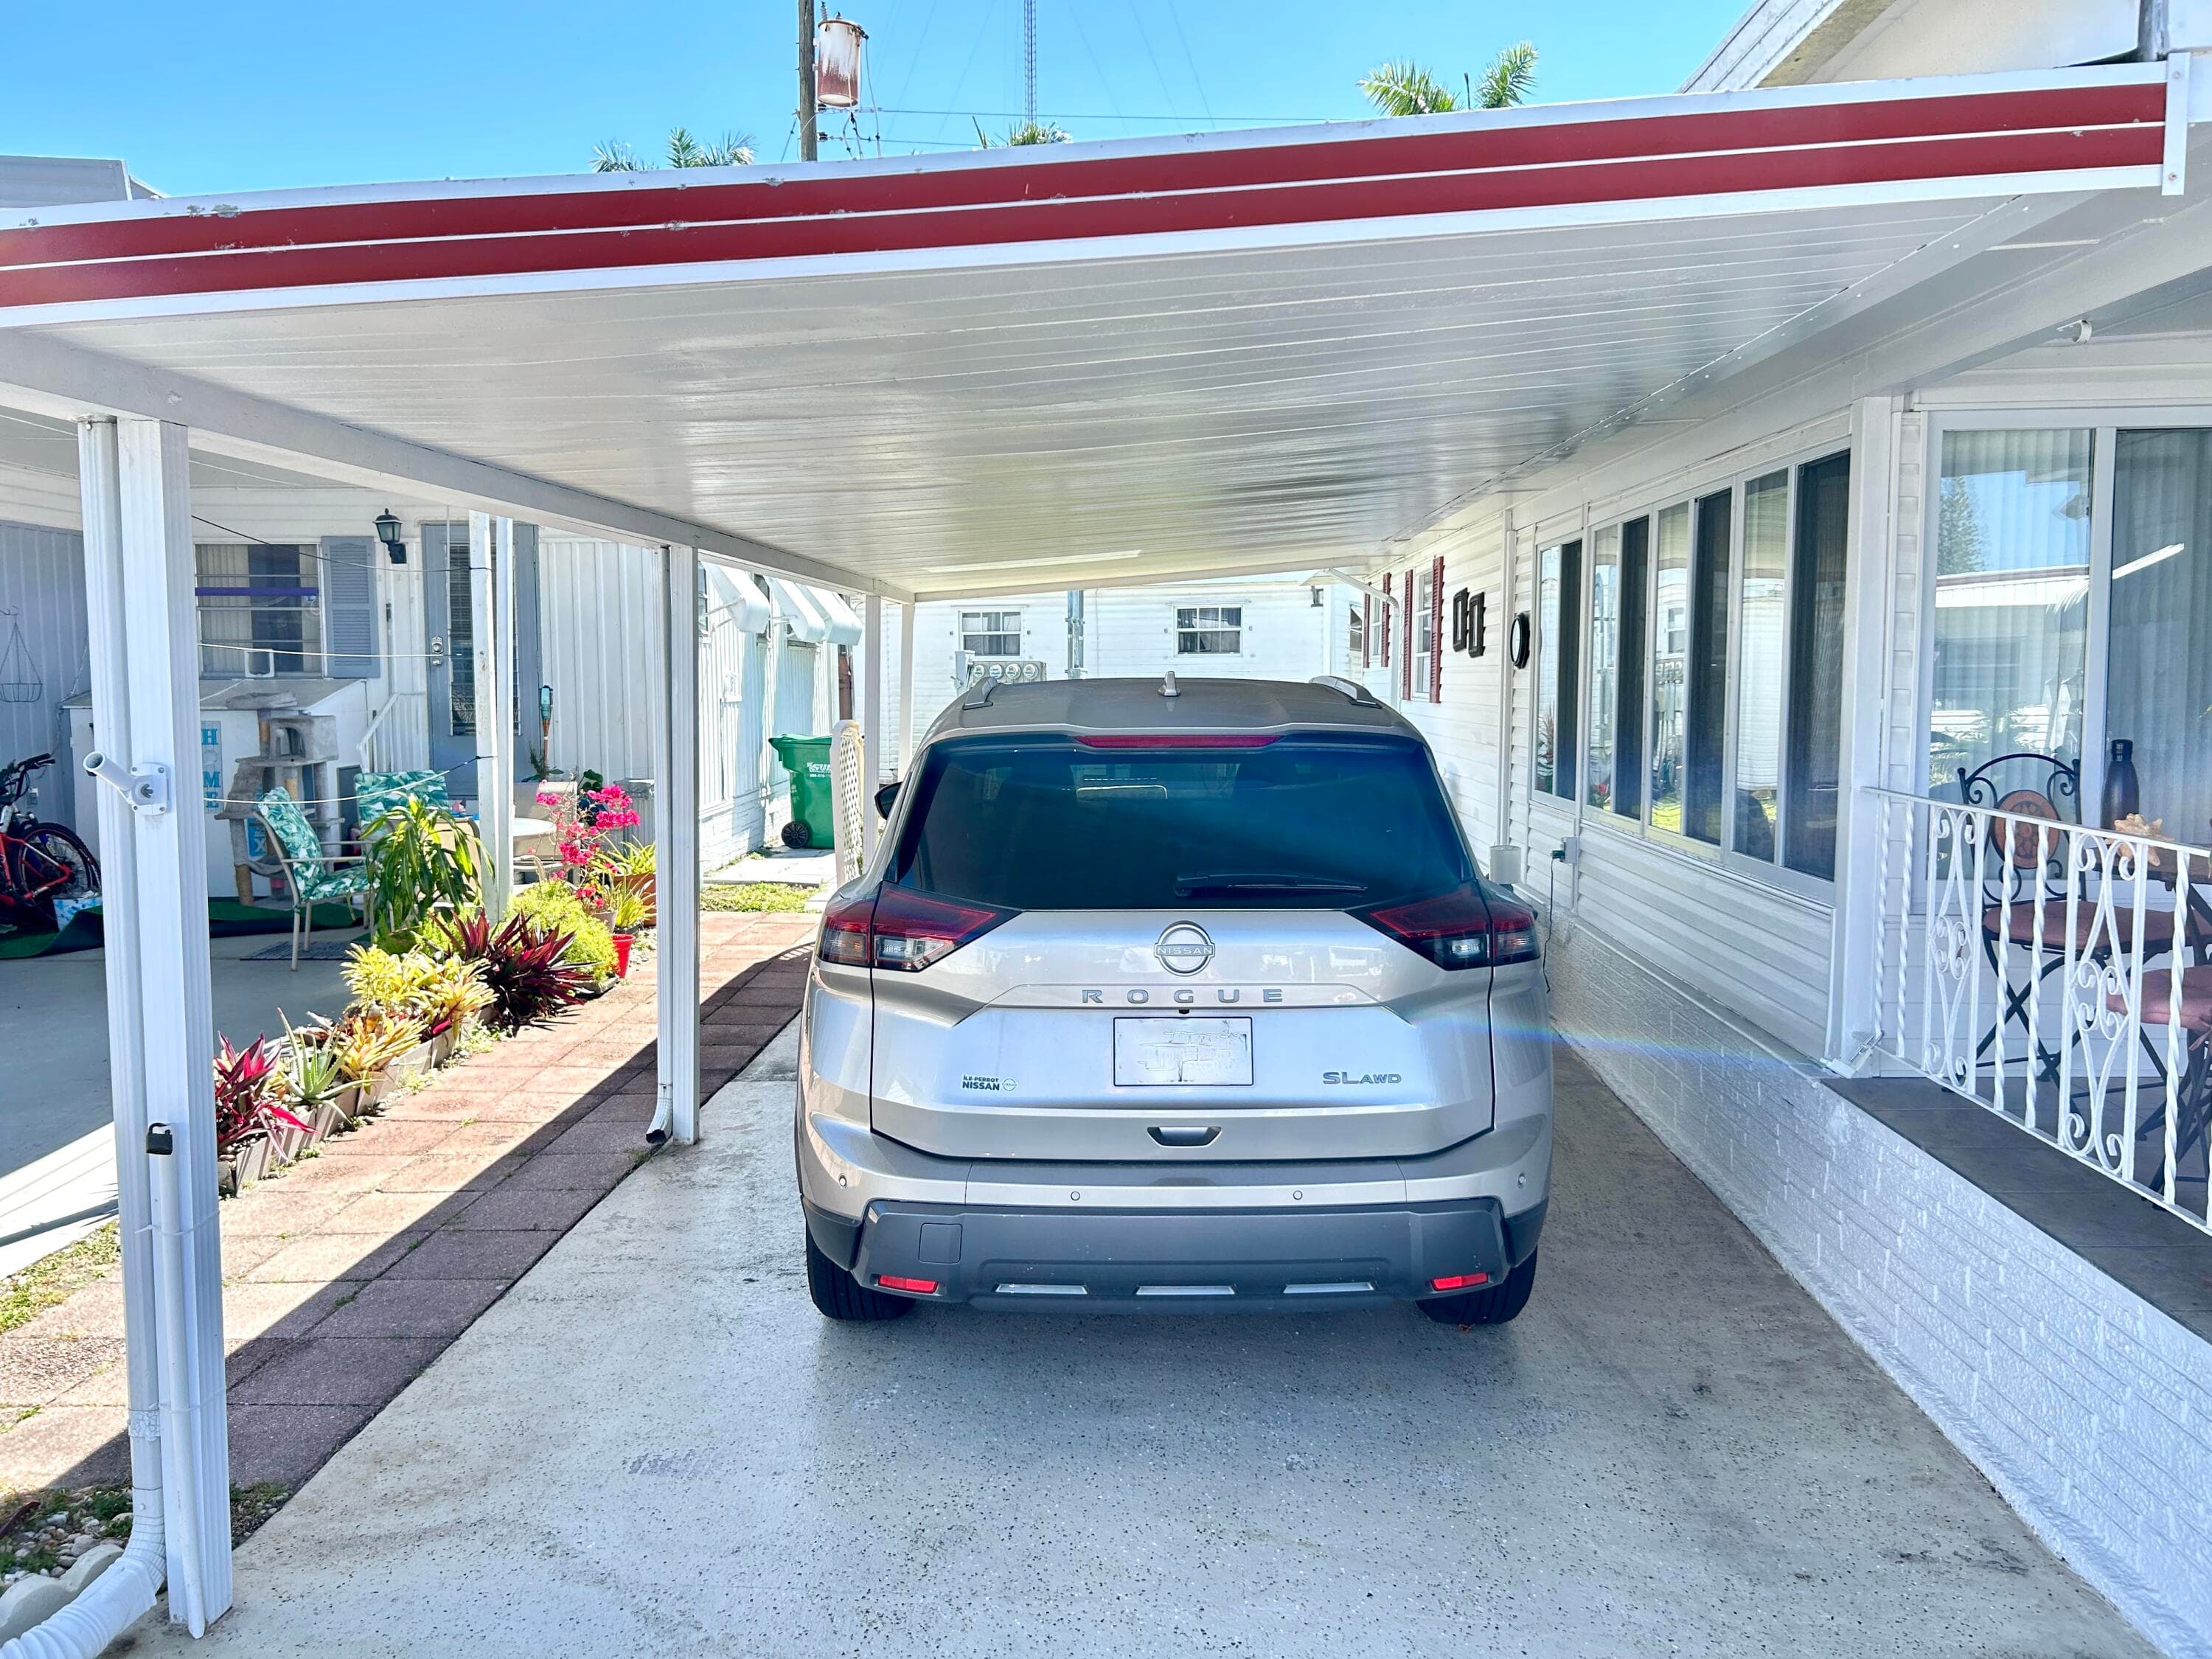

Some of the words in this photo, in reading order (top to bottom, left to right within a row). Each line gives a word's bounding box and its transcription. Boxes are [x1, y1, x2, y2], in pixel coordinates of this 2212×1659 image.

[1157, 947, 1213, 956] NISSAN
[1082, 990, 1283, 1004] ROGUE
[1359, 1074, 1402, 1084] AWD
[961, 1081, 1000, 1091] NISSAN
